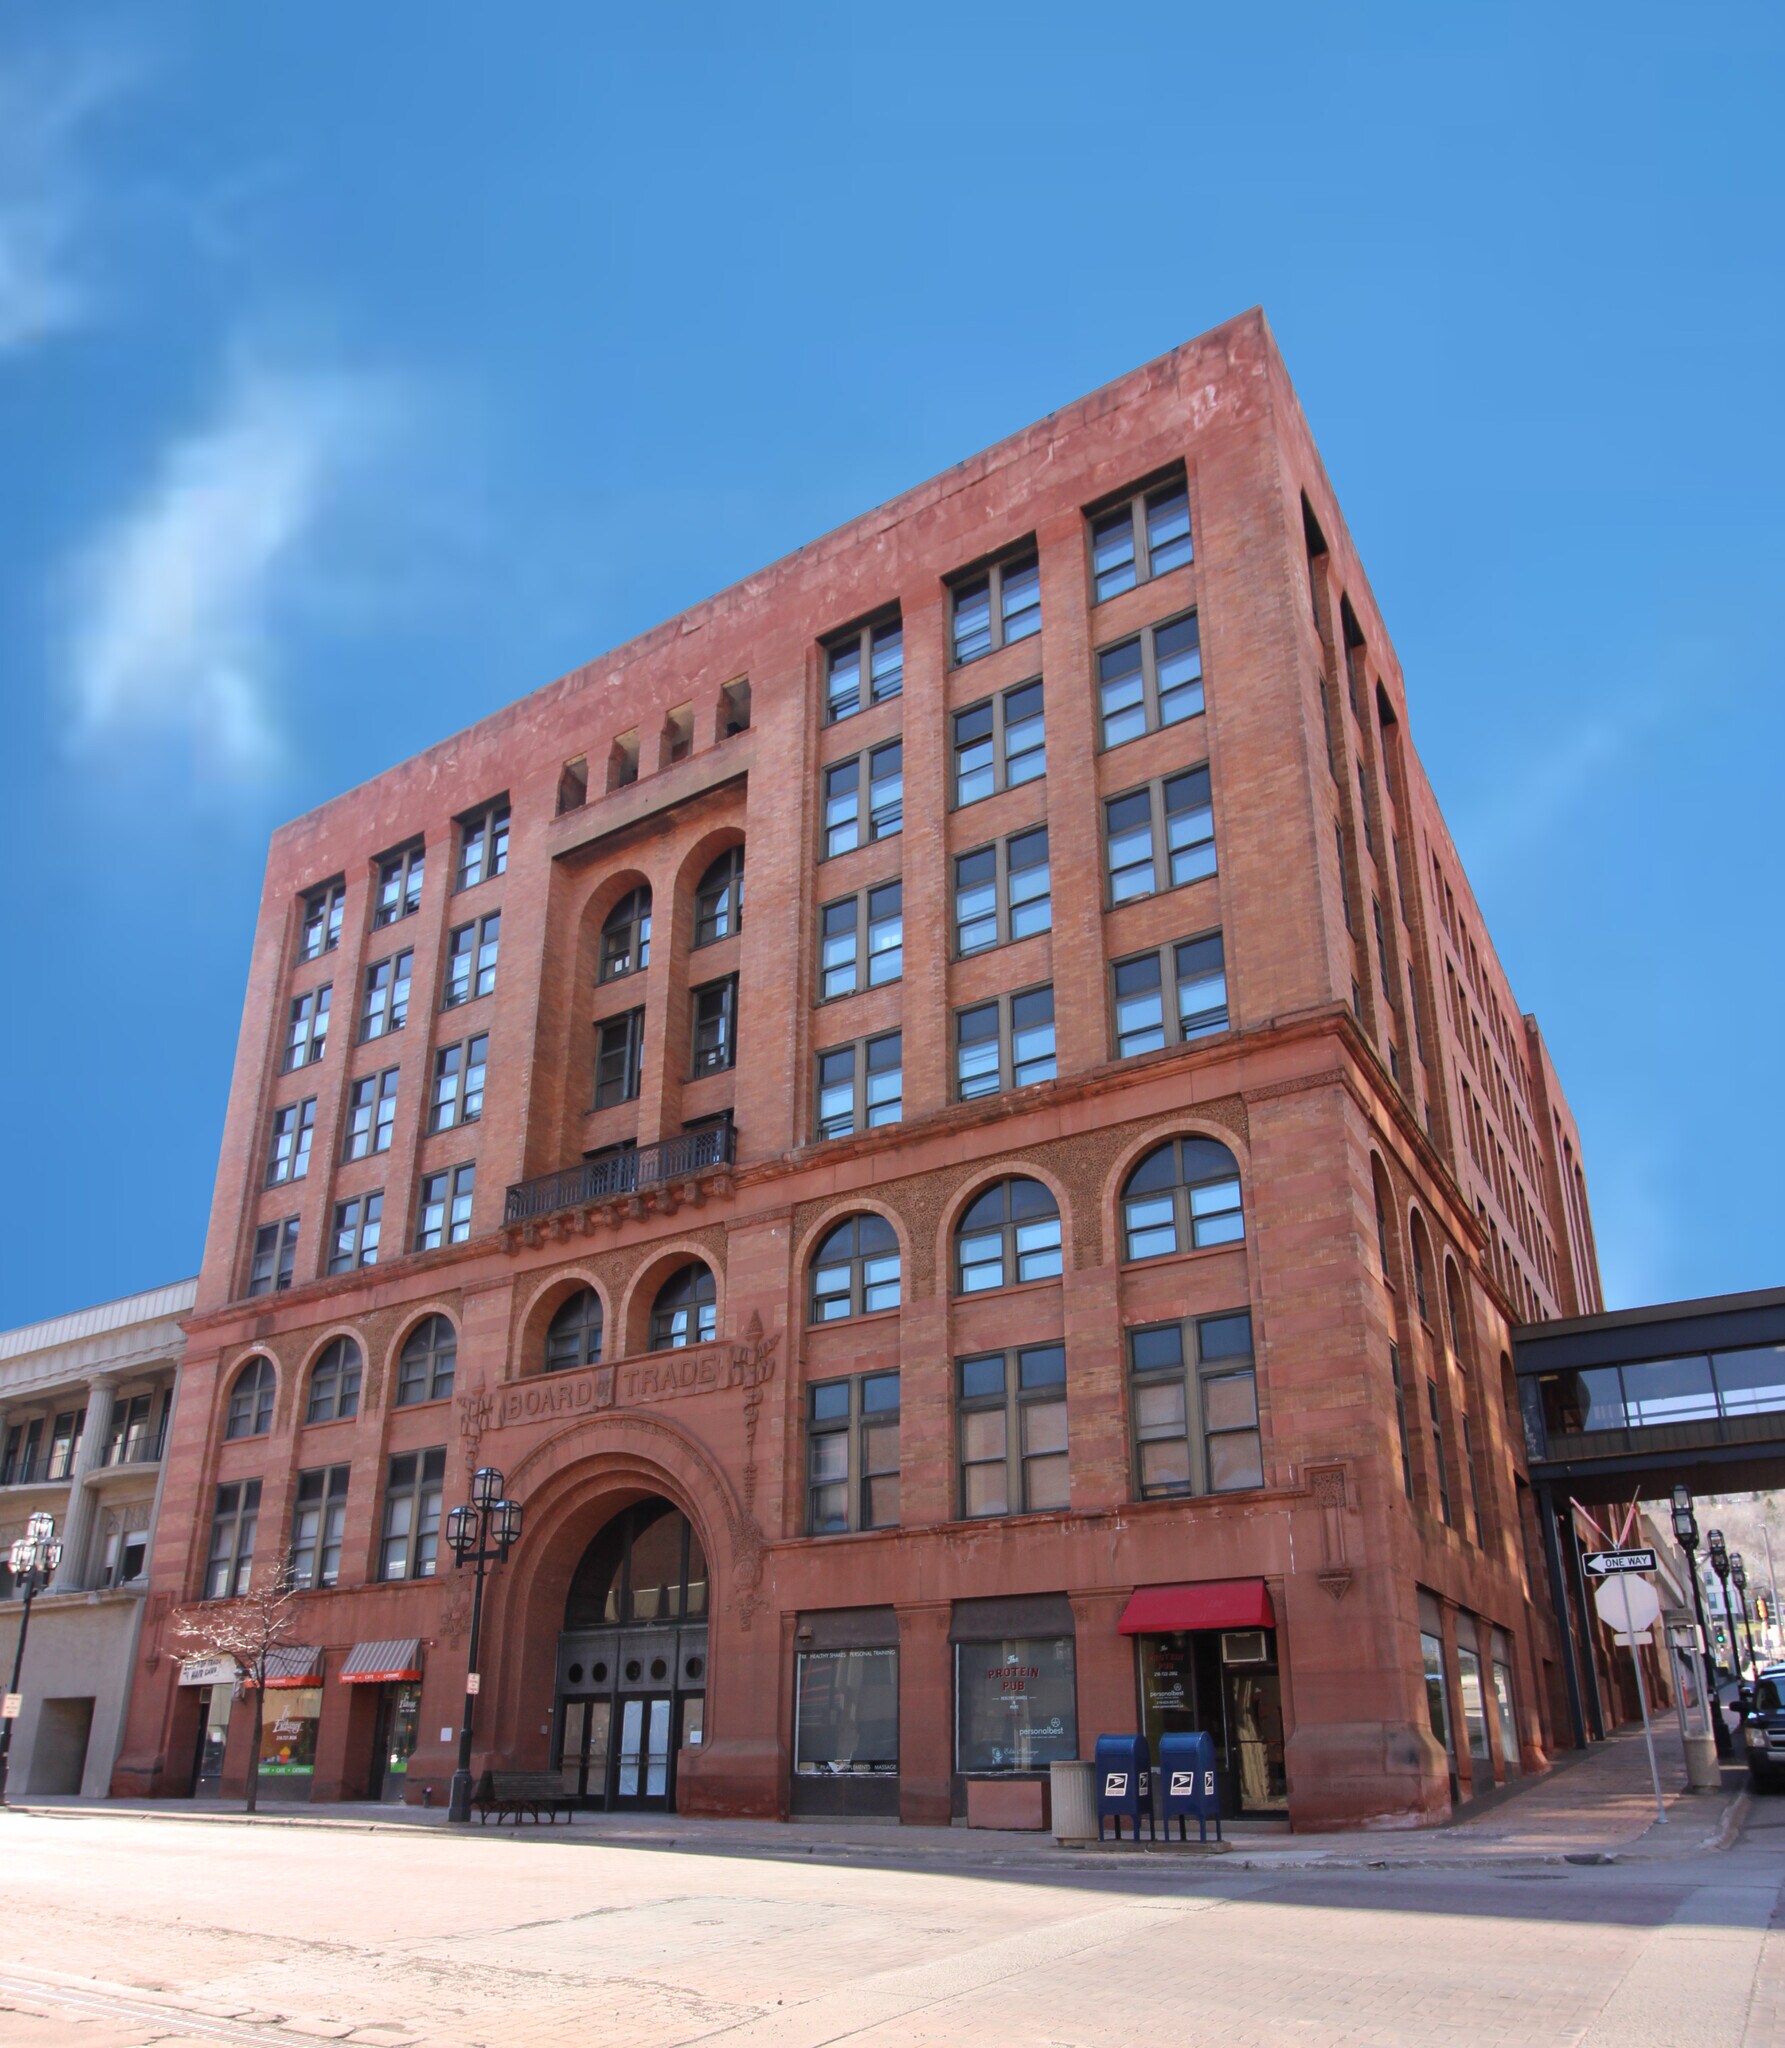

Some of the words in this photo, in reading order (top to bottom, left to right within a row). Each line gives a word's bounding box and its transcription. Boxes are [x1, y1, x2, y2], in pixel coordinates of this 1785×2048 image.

[507, 1382, 592, 1420] BOARD
[623, 1355, 717, 1397] TRADE
[1605, 1557, 1624, 1568] ONE
[1627, 1555, 1648, 1566] WAY
[1007, 1654, 1018, 1664] The
[988, 1667, 1039, 1679] PROTEIN
[1002, 1681, 1025, 1692] PUB
[1019, 1726, 1063, 1736] personalbest
